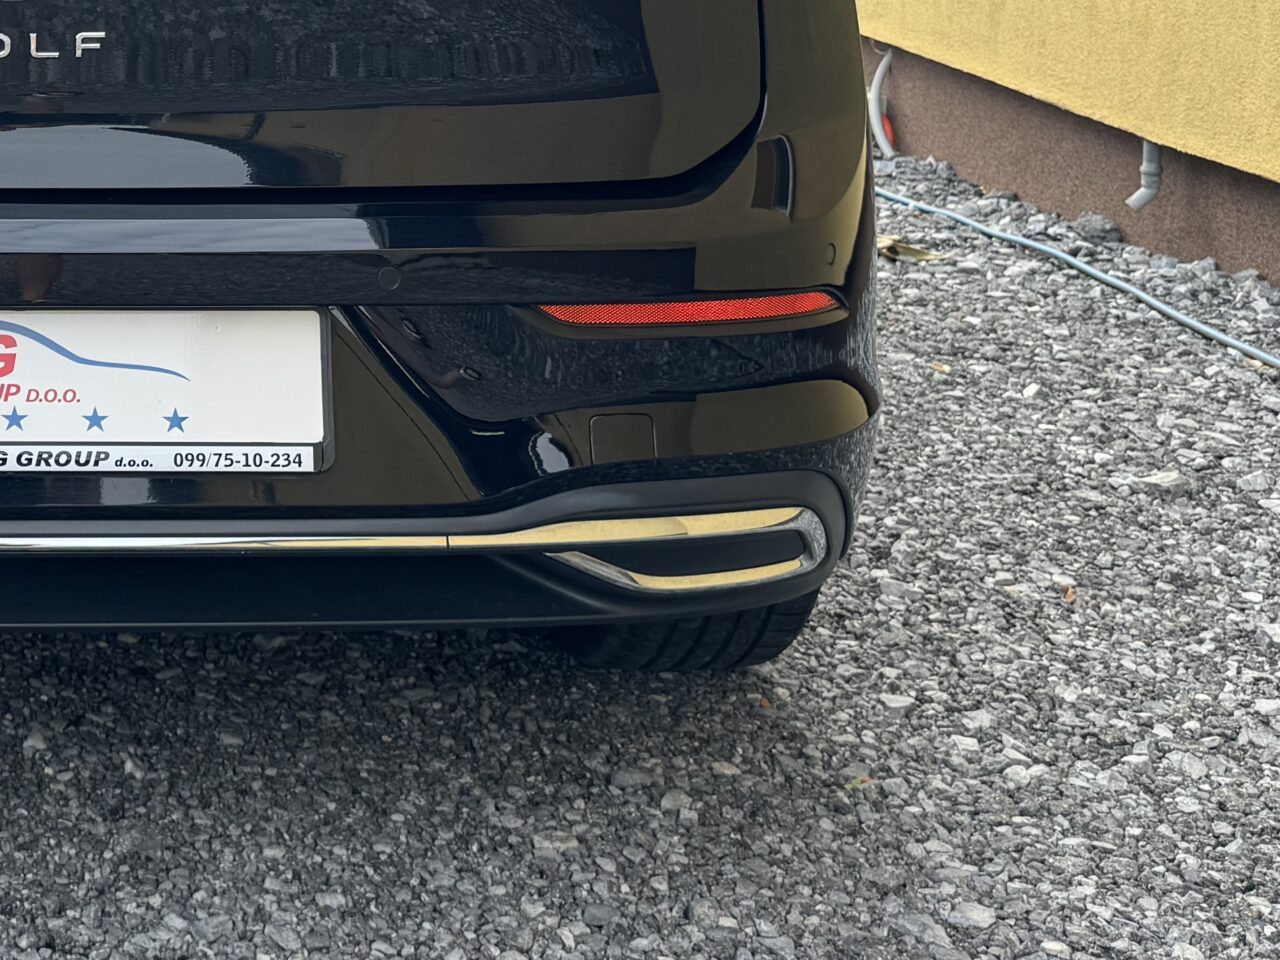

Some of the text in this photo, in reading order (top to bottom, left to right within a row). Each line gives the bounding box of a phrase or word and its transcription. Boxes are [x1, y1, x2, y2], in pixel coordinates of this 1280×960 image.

[25, 389, 81, 403] D.O.O.
[16, 450, 110, 468] GROUP
[114, 456, 153, 468] d.o.o.
[173, 452, 303, 469] 099/75-10-234
